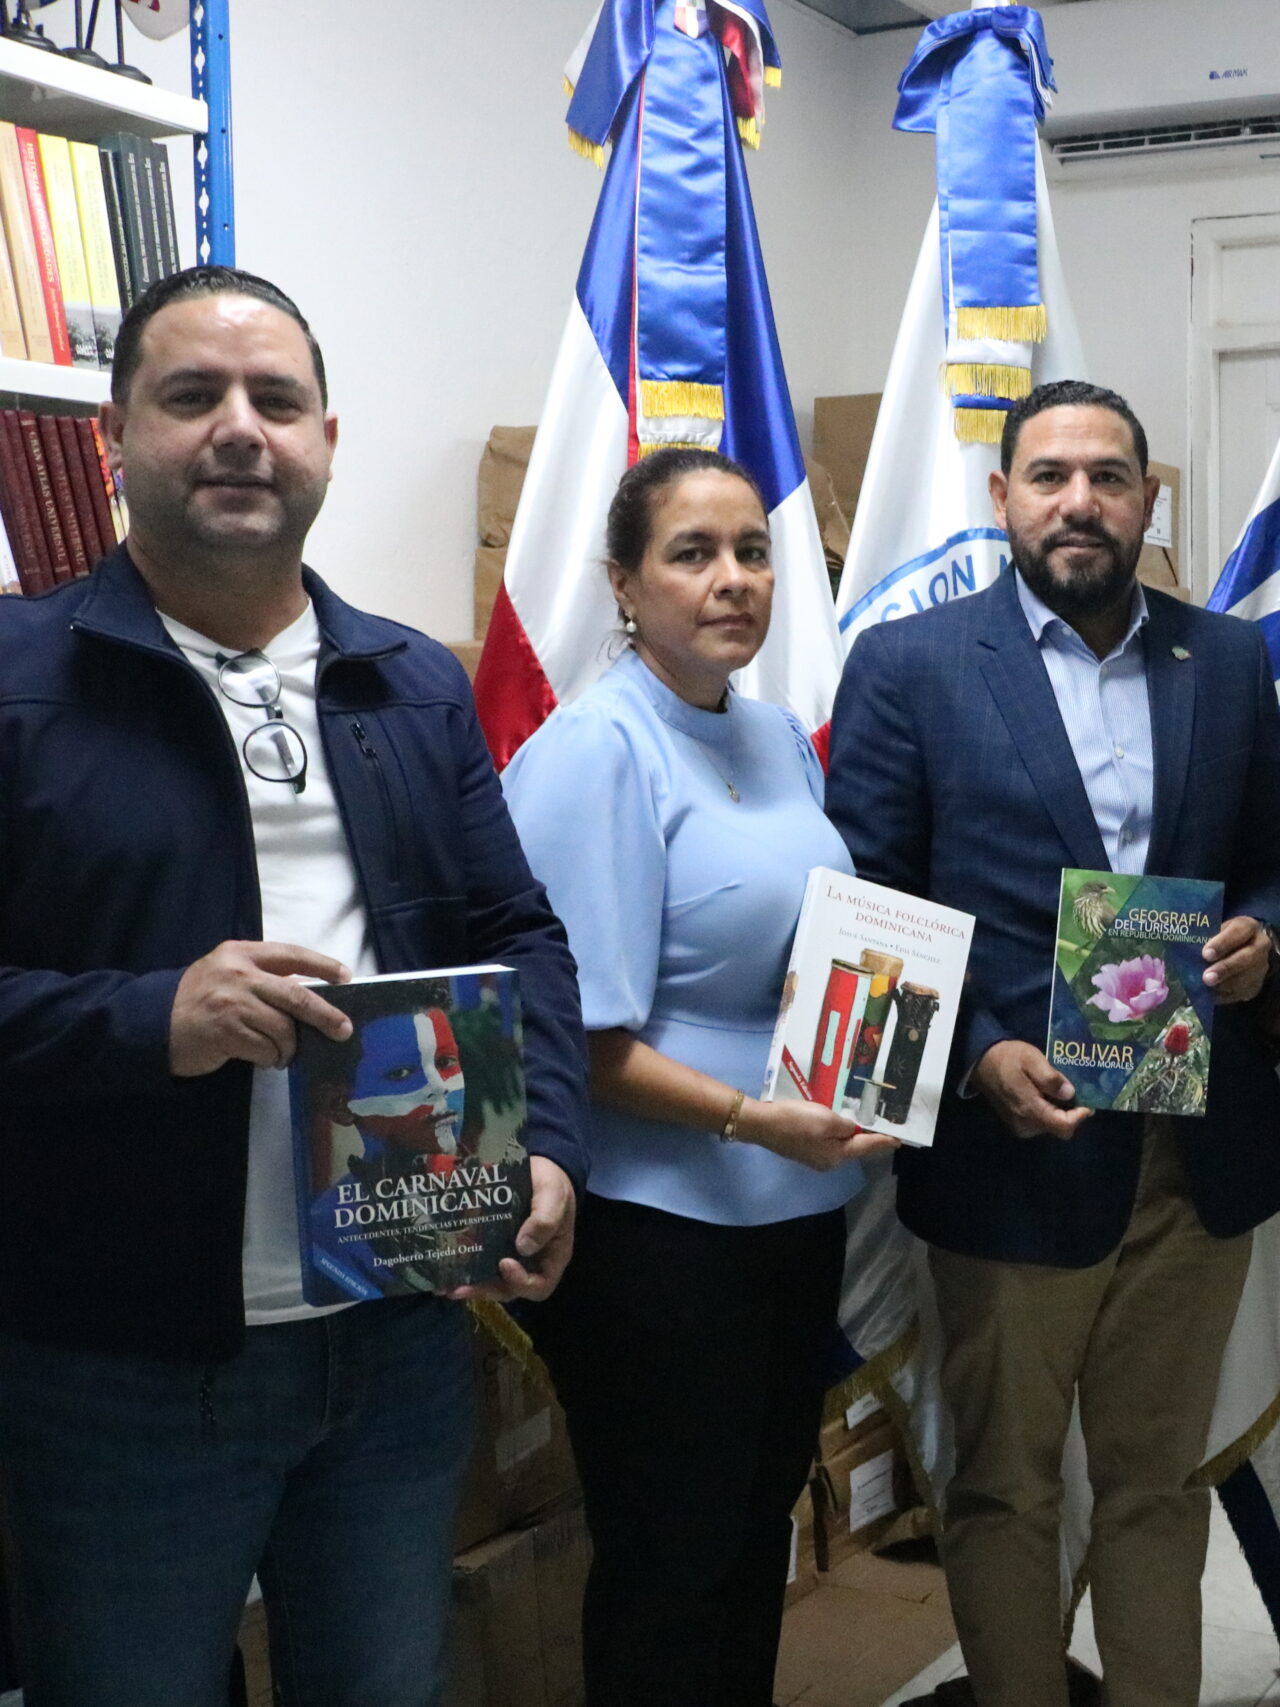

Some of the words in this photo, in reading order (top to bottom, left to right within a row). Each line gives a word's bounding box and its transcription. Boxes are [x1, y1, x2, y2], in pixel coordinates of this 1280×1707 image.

[24, 142, 42, 192] HISTORIA
[35, 463, 52, 499] ATLAS
[44, 499, 67, 562] UNIVERSAL
[827, 885, 843, 902] LA
[846, 895, 891, 916] MÚSICA
[895, 911, 966, 940] FOLCLÓRICA
[855, 911, 933, 943] DOMINICANA
[1114, 918, 1137, 931] DEL
[1138, 921, 1189, 936] TURISMO
[1128, 907, 1210, 928] GEOGRAFÍA
[1108, 929, 1119, 937] EN
[1162, 934, 1211, 944] DOMINICAN
[1053, 1057, 1096, 1067] TRONCOSO
[1097, 1059, 1134, 1071] MORALES
[338, 1182, 370, 1206] EL
[375, 1163, 508, 1196] CARNAVAL
[334, 1184, 513, 1229] DOMINICANO
[338, 1228, 401, 1244] ANTECEDENTES,
[403, 1221, 452, 1235] TENDENCIAS
[452, 1218, 458, 1227] Y
[459, 1212, 513, 1227] PERSPECTIVAS
[373, 1249, 424, 1268] Dagoberto
[426, 1247, 456, 1263] Tejeda
[458, 1242, 484, 1255] Ortiz
